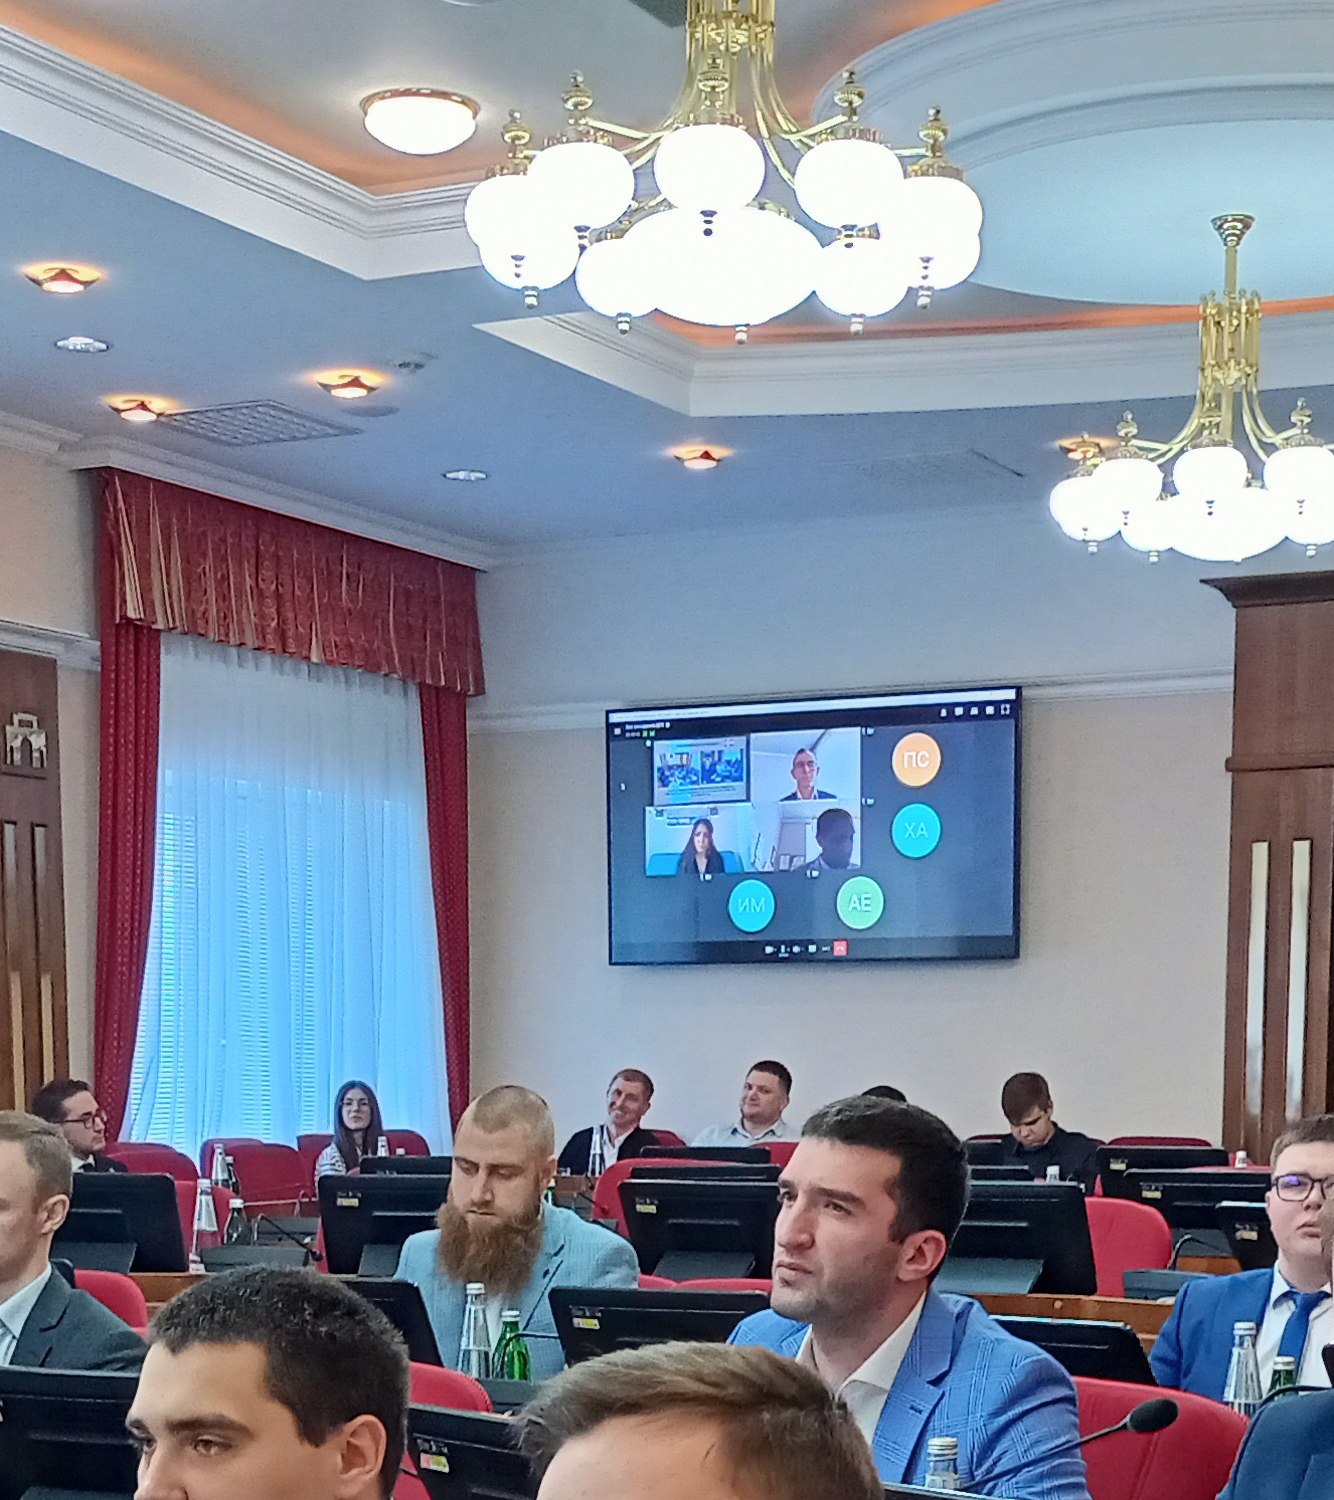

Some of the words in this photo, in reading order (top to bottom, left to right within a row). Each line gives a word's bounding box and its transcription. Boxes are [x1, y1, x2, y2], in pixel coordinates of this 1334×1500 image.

[904, 751, 930, 769] ПС
[904, 822, 928, 839] ХА
[738, 897, 766, 914] ИМ
[848, 893, 873, 912] АЕ
